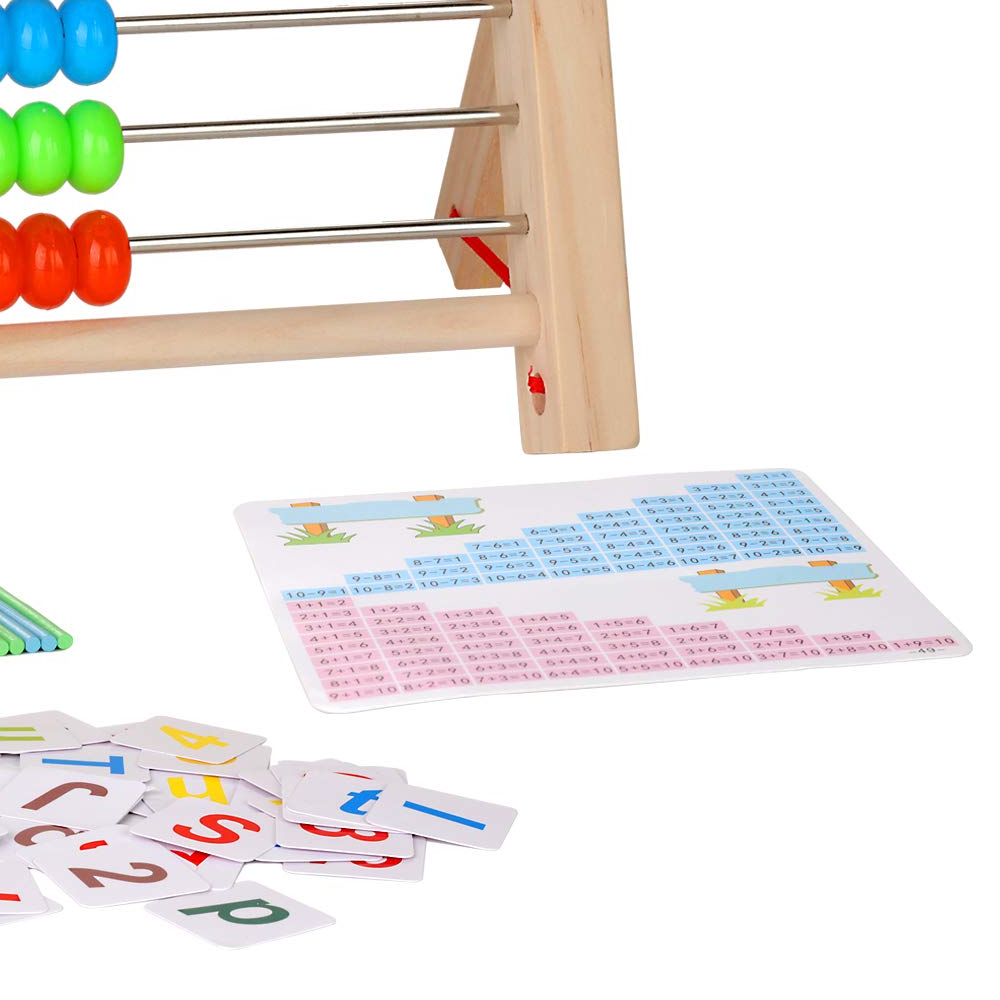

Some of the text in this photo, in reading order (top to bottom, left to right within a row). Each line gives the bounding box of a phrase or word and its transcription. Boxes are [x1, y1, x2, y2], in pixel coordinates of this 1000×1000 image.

[159, 725, 230, 750] 4
[172, 813, 261, 845] S
[68, 862, 169, 889] 2
